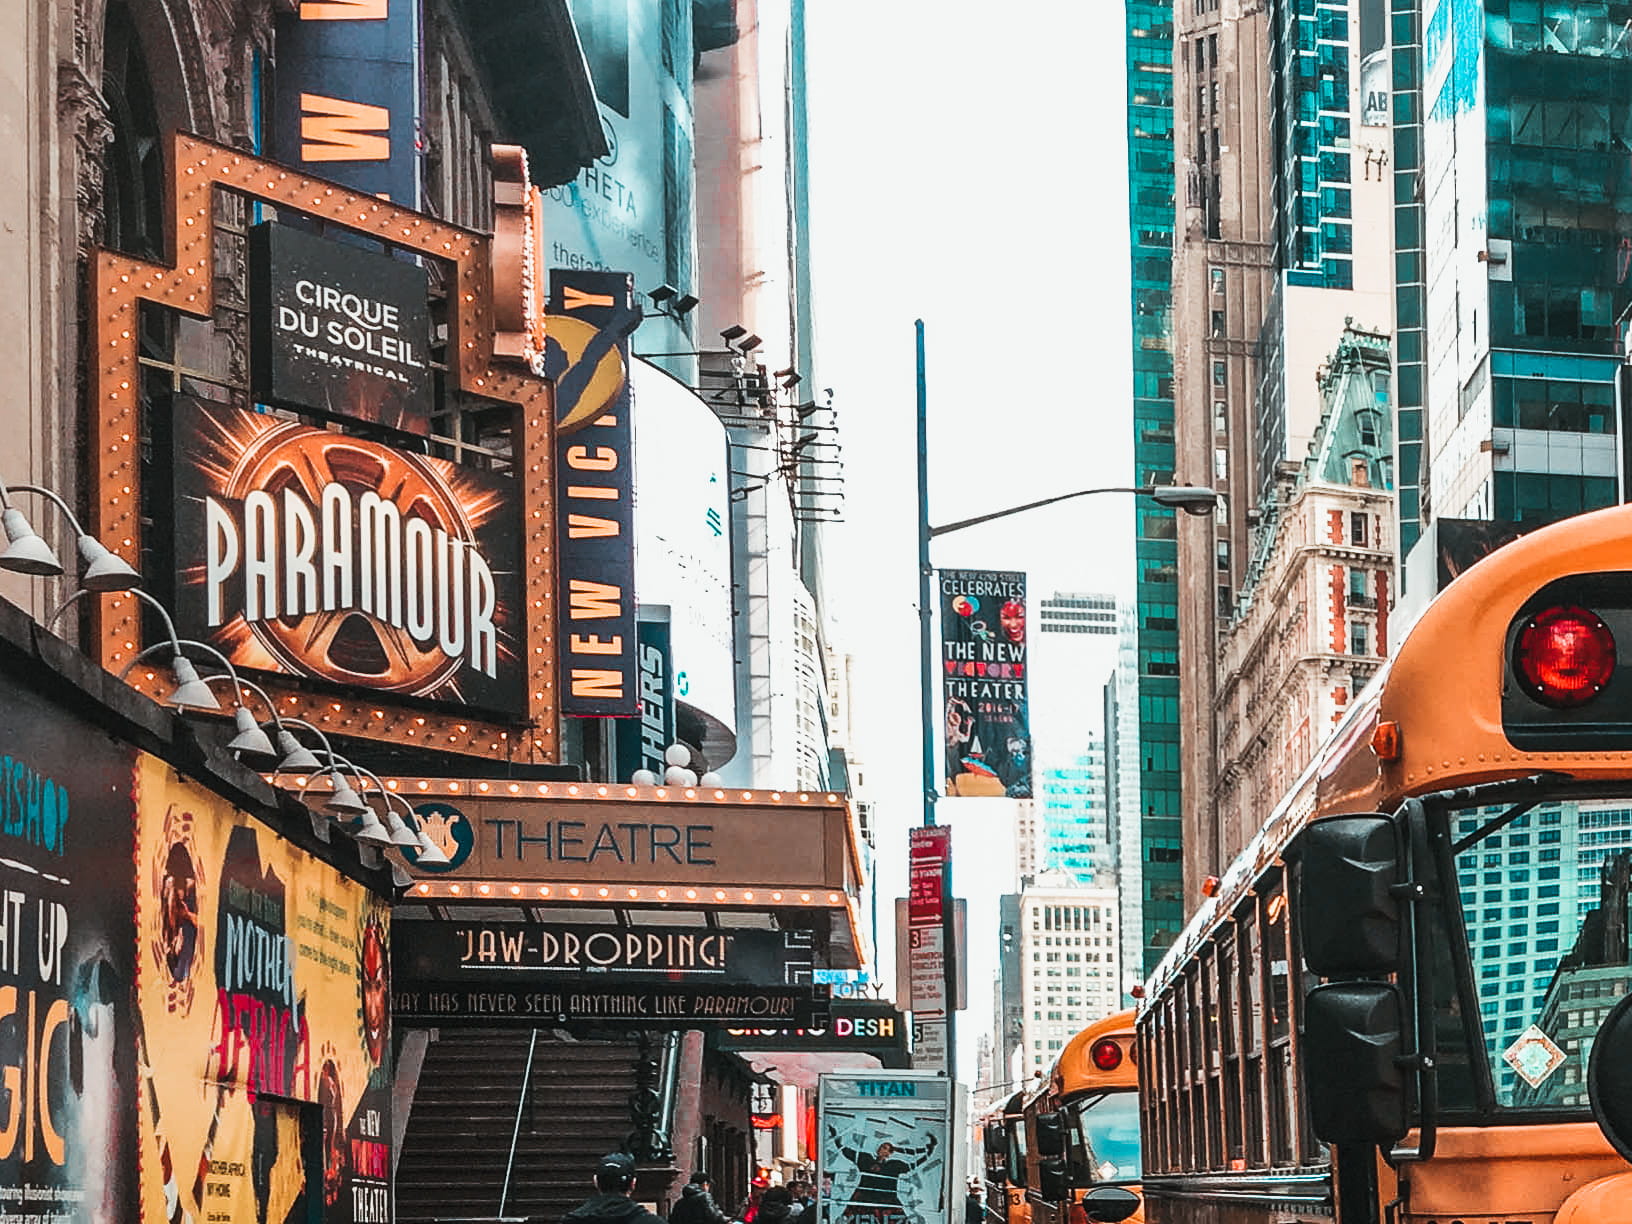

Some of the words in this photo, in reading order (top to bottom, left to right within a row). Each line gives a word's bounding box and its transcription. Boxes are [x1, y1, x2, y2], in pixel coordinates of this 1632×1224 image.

[279, 307, 322, 342] DU
[296, 279, 399, 332] CIRQUE
[292, 343, 410, 383] THEATRICAL
[206, 481, 498, 680] PARAMOUR
[942, 579, 1025, 598] CELEBRATES
[570, 579, 624, 699] NEW
[944, 641, 976, 660] THE
[982, 642, 1025, 662] NEW
[945, 681, 1025, 701] THEATER
[0, 750, 69, 857] ISHOP
[484, 818, 717, 867] THEATRE
[38, 899, 68, 985] UP
[225, 911, 300, 1034] MOTHER
[429, 992, 459, 1013] HAS
[468, 993, 517, 1014] NEVER
[525, 994, 562, 1014] SEEN
[570, 993, 648, 1015] ANYTHING
[655, 995, 687, 1015] LIKE
[210, 985, 312, 1105] AFRICA
[857, 1081, 916, 1097] TITAN
[351, 1186, 389, 1223] THEATER
